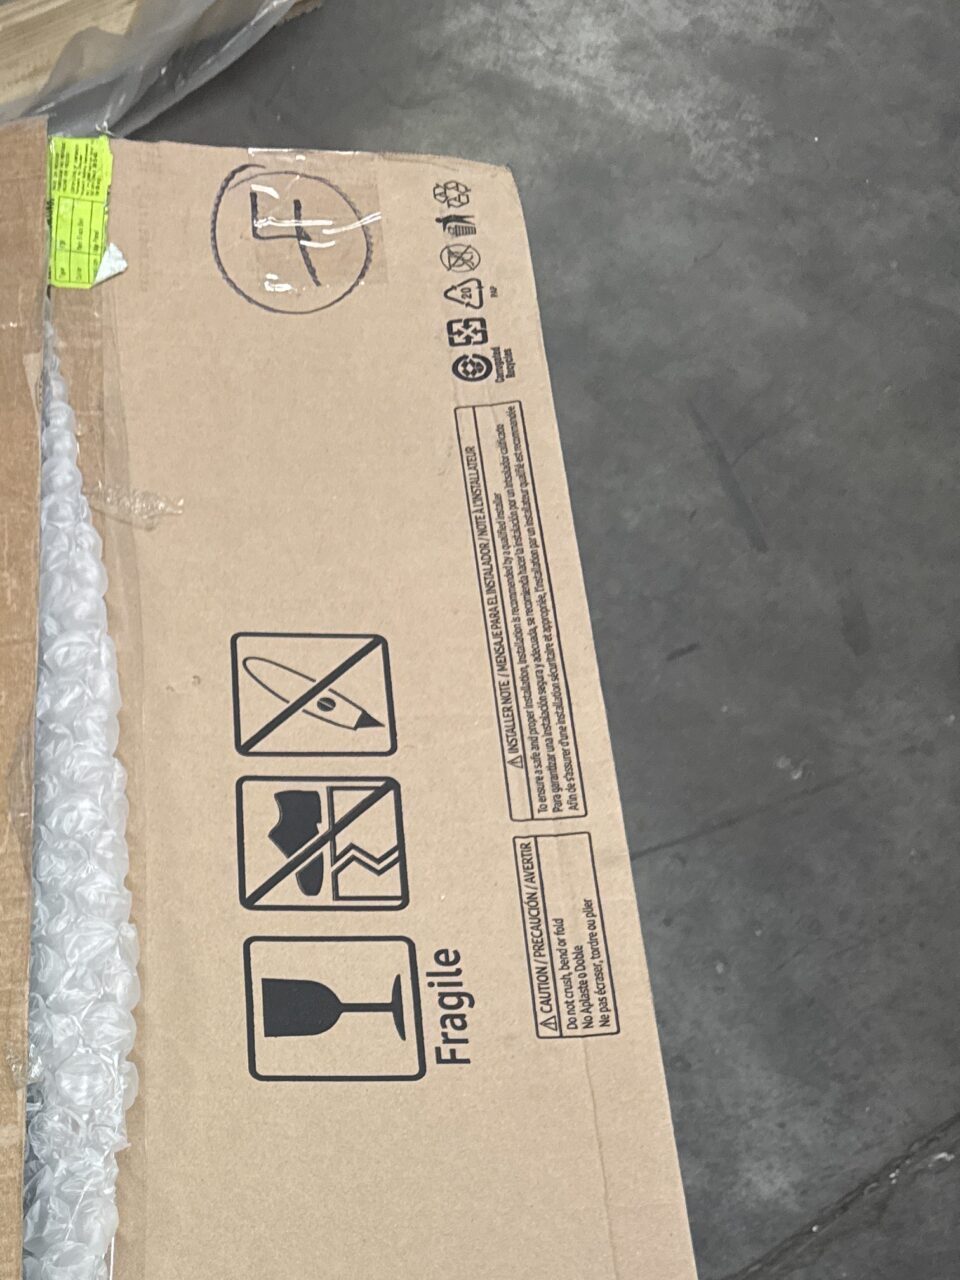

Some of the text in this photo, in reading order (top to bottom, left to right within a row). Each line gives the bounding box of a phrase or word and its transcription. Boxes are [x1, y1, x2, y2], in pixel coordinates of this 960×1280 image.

[461, 288, 472, 299] 20
[474, 515, 487, 536] NOTE
[479, 543, 496, 594] INSTALADOR
[486, 594, 498, 605] EL
[488, 606, 501, 629] PARA
[491, 630, 507, 671] MENSAJE
[492, 493, 548, 813] To ensure safe and proper installation, installation recommended by qualified installer
[498, 681, 511, 704] NOTE
[502, 706, 518, 753] INSTALLER
[520, 842, 552, 1013] CAUTION PRECAUCIÓN AVERTIR
[552, 918, 578, 1029] Do not crush, bend or fold
[573, 945, 593, 1028] No Aplaste Doble
[583, 898, 611, 1027] Ne pas écraser, tordre ou plier
[426, 948, 475, 1064] Fragile
